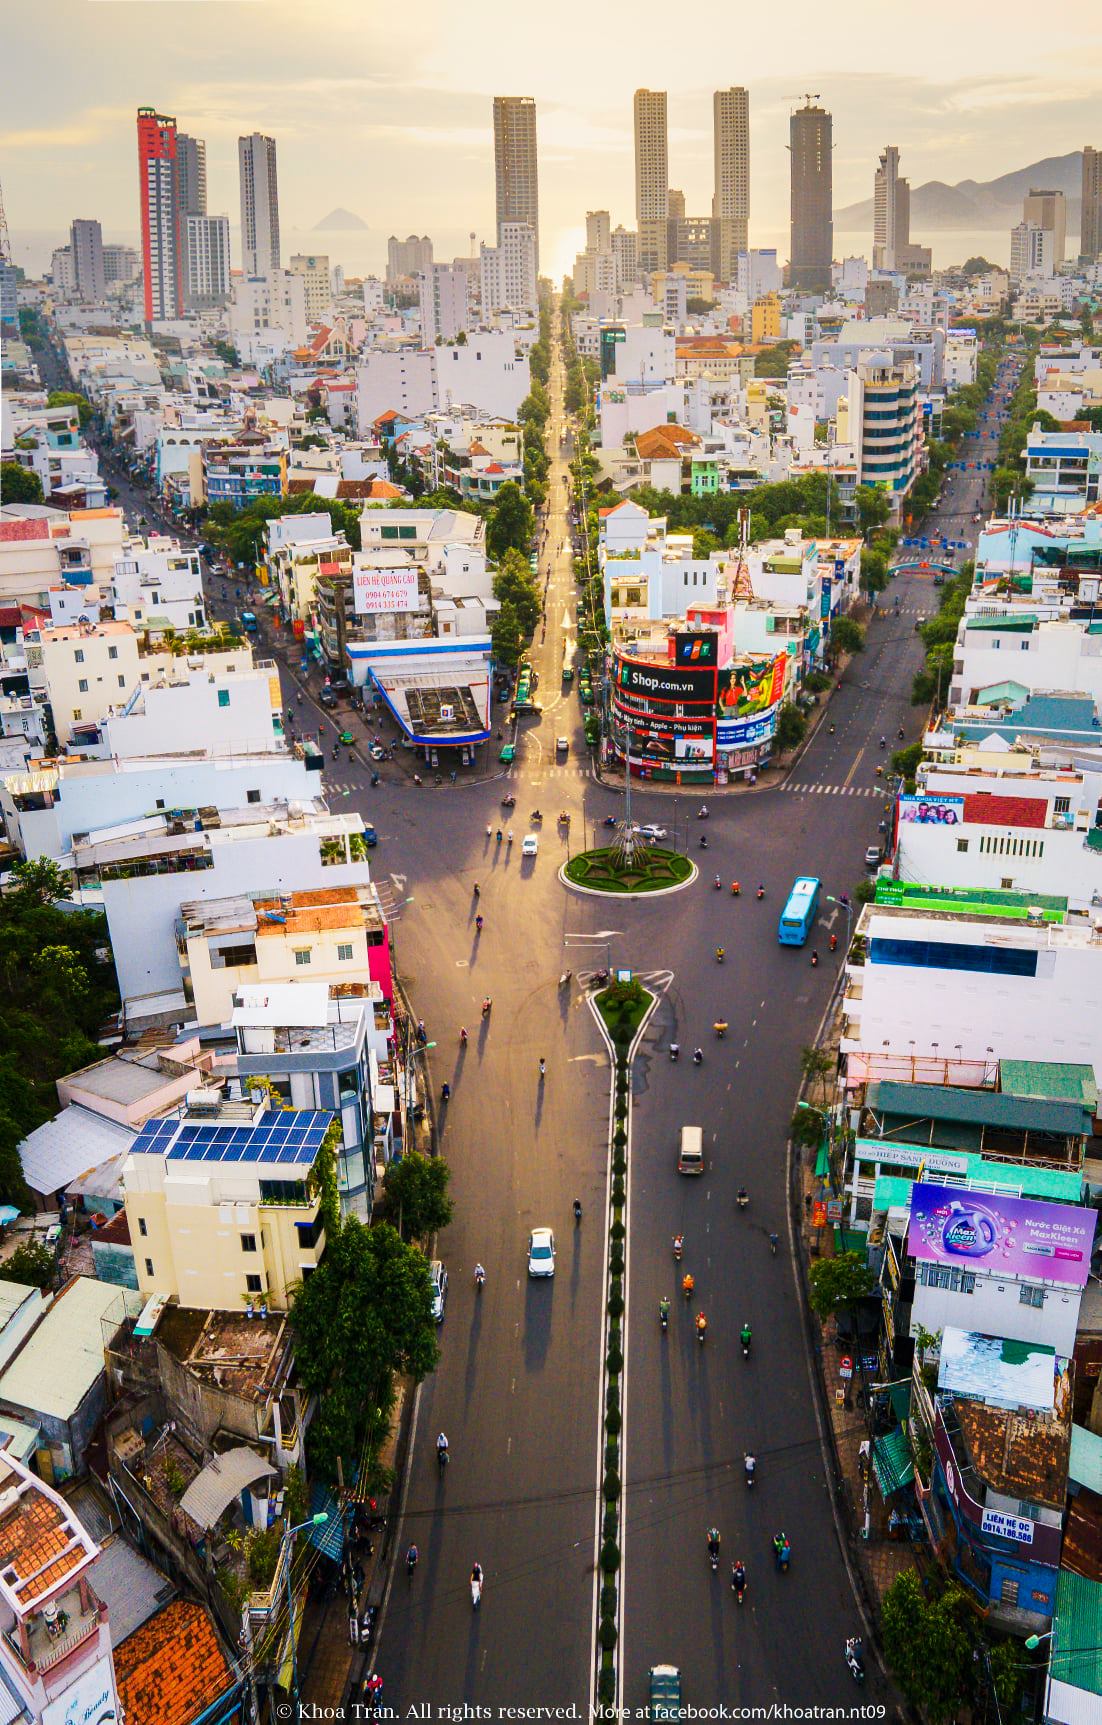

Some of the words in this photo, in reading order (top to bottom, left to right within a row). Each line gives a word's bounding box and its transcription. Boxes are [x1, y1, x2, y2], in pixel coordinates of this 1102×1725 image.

[632, 672, 694, 691] Shop.com.vn
[650, 721, 668, 730] Apple
[1024, 1219, 1050, 1228] Nước
[1030, 1229, 1078, 1243] MaxKleen
[986, 1513, 1004, 1525] LIÊN
[1006, 1518, 1017, 1529] HỆ
